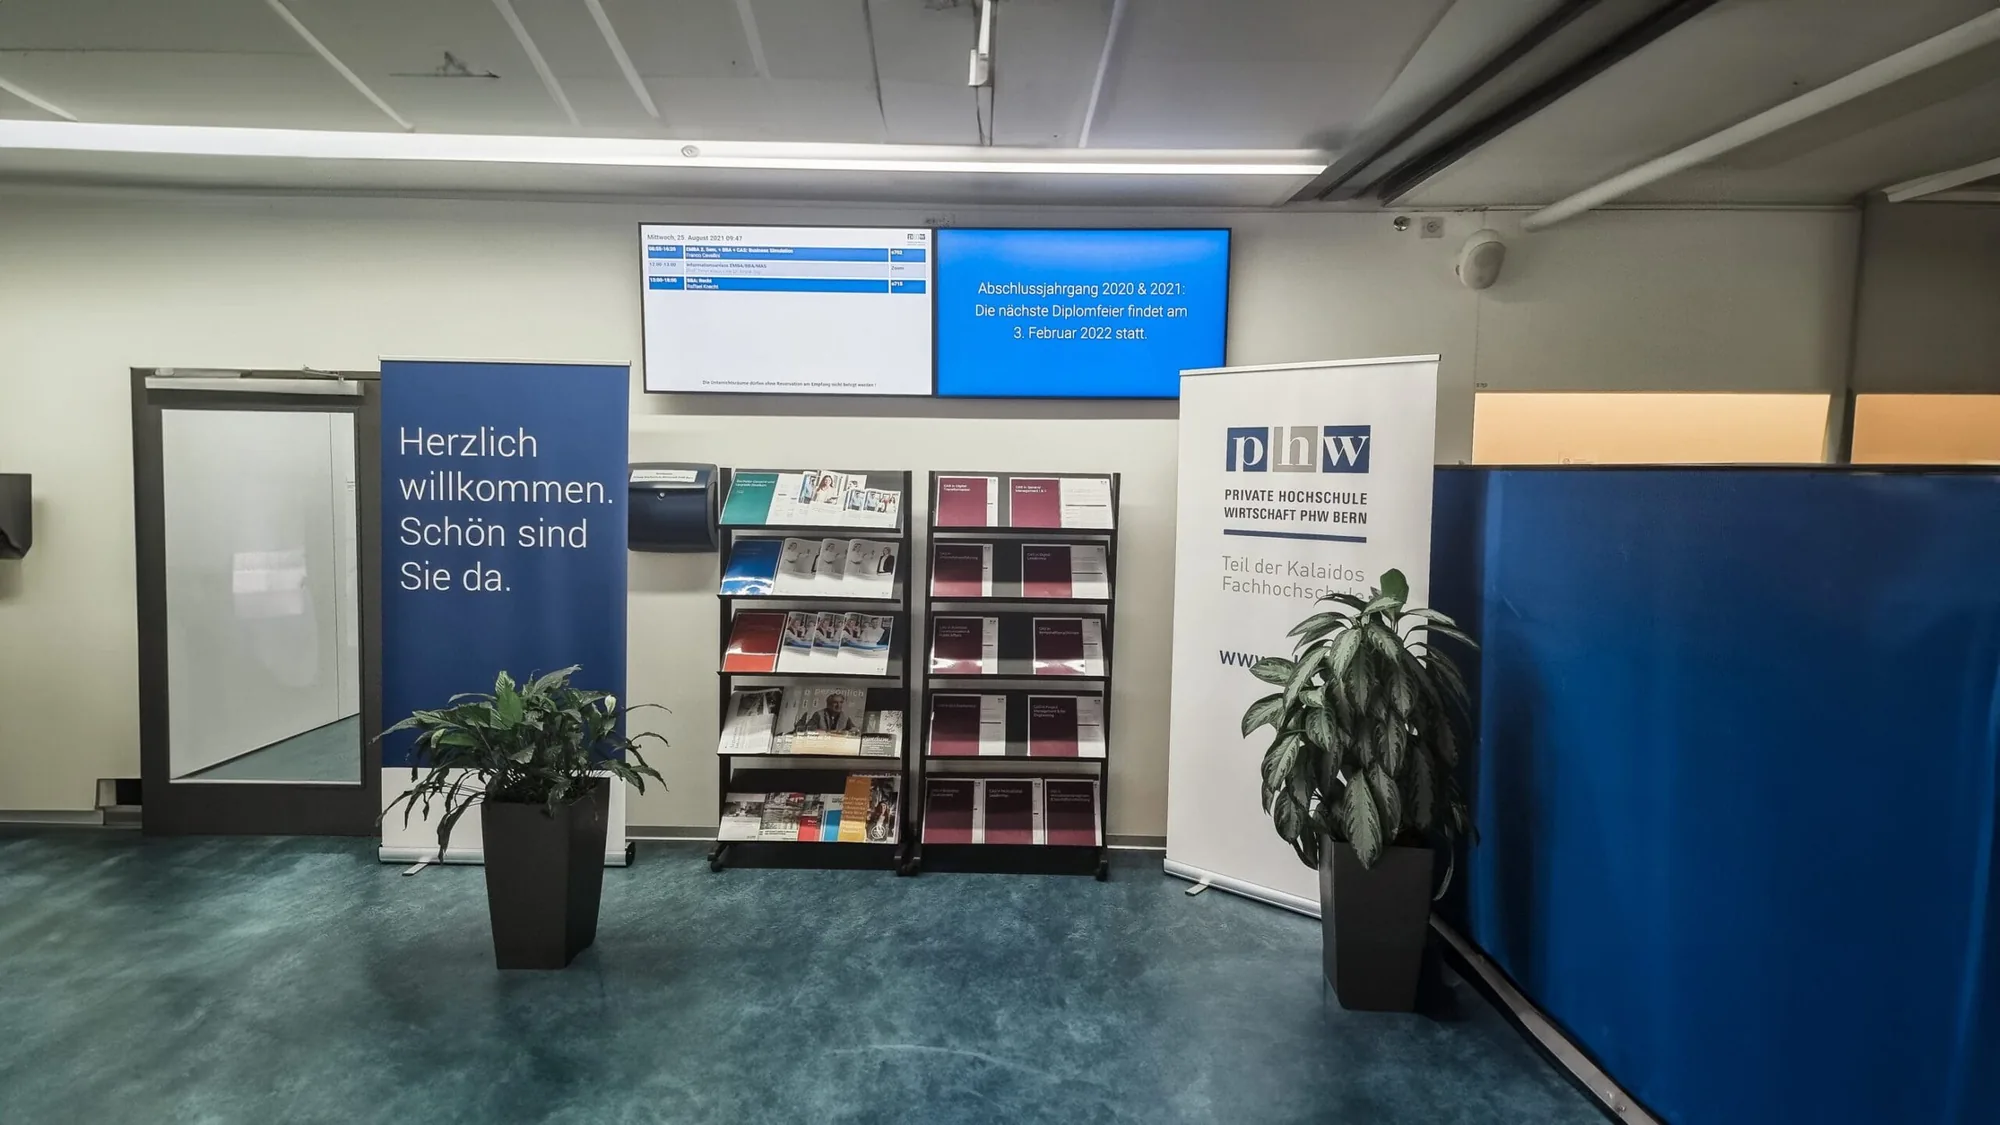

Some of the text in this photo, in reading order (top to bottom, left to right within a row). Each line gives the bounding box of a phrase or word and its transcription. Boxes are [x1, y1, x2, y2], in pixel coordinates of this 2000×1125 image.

[978, 282, 1185, 298] Abschlussjahrgang 2020 & 2021:
[975, 305, 1188, 319] Die nächste Diplomfeier findet am
[1014, 327, 1147, 340] 3. Februar 2022 statt.
[400, 426, 537, 457] Herzlich
[1229, 426, 1370, 472] phw
[400, 470, 613, 504] willkommen.
[1225, 489, 1367, 505] PRIVATE HOCHSCHULE
[1224, 507, 1367, 524] WIRTSCHAFT PHW BERN
[400, 516, 587, 548] Schön sind
[400, 560, 511, 591] Sie da.
[1222, 555, 1365, 582] Teil der Kalaidos
[1222, 576, 1365, 600] Fachhochsche
[814, 688, 864, 697] persönlich
